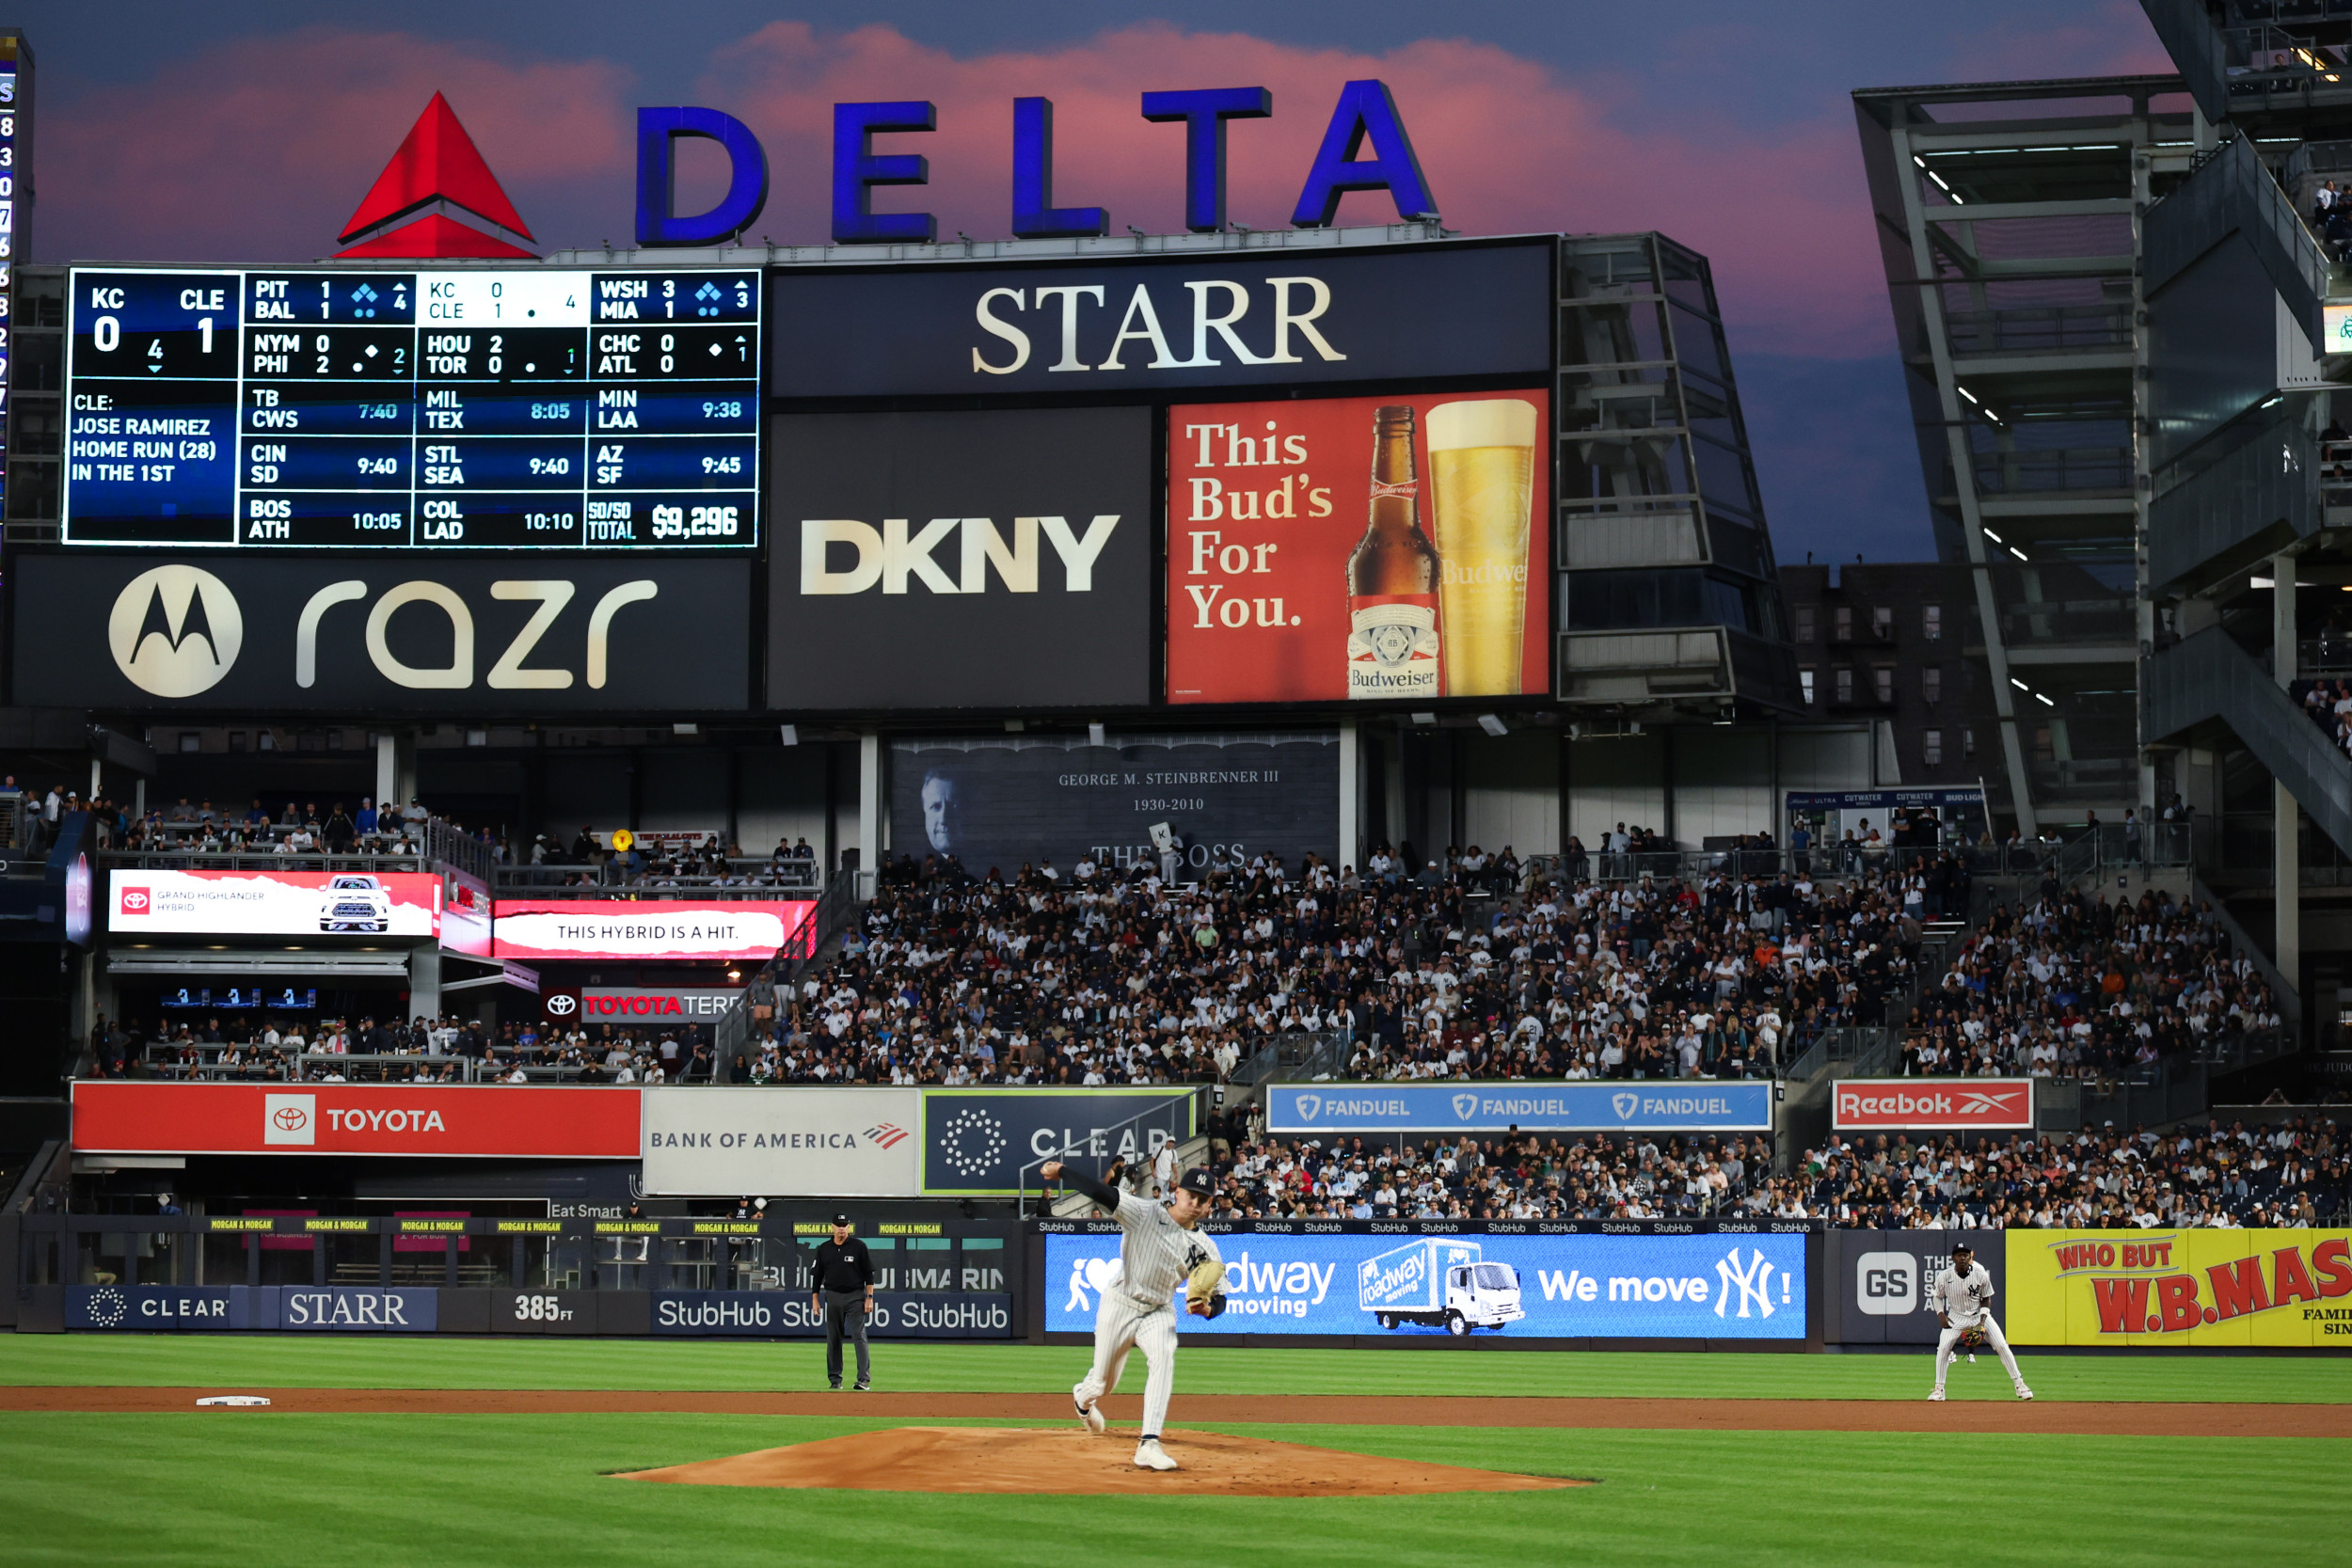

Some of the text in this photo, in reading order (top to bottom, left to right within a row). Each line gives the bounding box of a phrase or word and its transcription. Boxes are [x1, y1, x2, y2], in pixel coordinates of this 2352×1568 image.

[635, 79, 1440, 248] DELTA
[256, 281, 329, 298] PIT 1
[430, 282, 501, 297] KC 0
[600, 280, 675, 298] WSH 3
[92, 289, 224, 310] KC CLE
[393, 294, 406, 309] 4
[565, 294, 576, 308] 4
[737, 292, 748, 308] 3
[255, 301, 329, 319] BAL 1
[430, 303, 501, 318] CLE 1
[600, 302, 674, 319] MIA 1
[94, 316, 212, 353] 0 1
[972, 277, 1347, 376] STARR
[148, 340, 163, 359] 4
[254, 335, 328, 352] NYM 0
[427, 336, 502, 353] HOU 2
[599, 335, 674, 352] CHC 0
[254, 356, 329, 373] PHI 2
[394, 348, 405, 364] 2
[426, 356, 501, 373] TOR 0
[598, 356, 674, 372] ATL 0
[74, 395, 113, 411] CLE:
[252, 389, 278, 406] TB
[426, 390, 462, 407] MIL
[599, 390, 637, 407] MIN
[359, 404, 398, 419] 7:40
[531, 404, 570, 419] 8:05
[703, 402, 741, 418] 9:38
[73, 419, 210, 436] JOSE RAMIREZ
[252, 411, 298, 428] CWS
[426, 412, 464, 429] TEX
[598, 411, 638, 428] LAA
[72, 441, 216, 461] HOME RUN (28)
[1186, 420, 1308, 469] This
[251, 445, 286, 462] CIN
[425, 446, 462, 463] STL
[596, 446, 624, 463] AZ
[72, 465, 175, 482] IN THE 1ST
[358, 458, 397, 474] 9:40
[530, 458, 569, 474] 9:40
[702, 457, 740, 473] 9:45
[251, 466, 278, 483] SD
[424, 467, 464, 483] SEA
[596, 467, 623, 483] SF
[1187, 472, 1332, 522] Bud's
[250, 500, 291, 517] BOS
[423, 501, 463, 518] COL
[249, 521, 290, 539] ATH
[352, 514, 402, 530] 10:05
[525, 514, 573, 530] 10:10
[652, 504, 738, 539] $9,296
[423, 522, 463, 539] LAD
[588, 521, 636, 540] TOTAL
[800, 514, 1121, 595] DKNY
[1187, 531, 1277, 576] For
[1184, 582, 1302, 629] You.
[296, 579, 659, 689] razr
[1352, 670, 1434, 687] Budweiser
[1058, 770, 1279, 786] GEORGE M. STEINBRENNER III
[1133, 798, 1203, 811] 1930-2010
[157, 892, 264, 901] GRAND HIGHLANDER
[157, 903, 195, 911] HYBRID
[558, 926, 739, 939] THIS HYBRID IS A HIT.
[584, 996, 681, 1015] TOYOTA
[1325, 1100, 1731, 1116] FANDUEL FANDUEL FANDUEL
[1840, 1093, 1951, 1117] Reebok
[326, 1108, 446, 1132] TOYOTA
[651, 1132, 858, 1149] BANK OF AMERICA
[551, 1205, 622, 1217] Eat Smart
[212, 1220, 272, 1229] MORGAN & MORGAN
[694, 1224, 758, 1232] MORGAN & MORGAN
[880, 1225, 940, 1234] MORGAN & MORGAN
[1039, 1222, 1074, 1232] StubHub
[1255, 1223, 1342, 1232] StubHub StubHub
[1371, 1223, 1526, 1232] StubHub StubHub StubHub
[1601, 1223, 1757, 1233] StubHub StubHub
[2055, 1242, 2171, 1271] WHO BUT
[1363, 1248, 1425, 1305] roadway
[1866, 1270, 1908, 1297] GS
[1385, 1279, 1418, 1303] moving
[1537, 1270, 1597, 1302] We
[1609, 1276, 1708, 1302] move
[141, 1299, 226, 1317] CLEAR
[290, 1292, 408, 1325] STARR
[515, 1295, 559, 1321] 385
[659, 1300, 1008, 1328] StubHub StubHub
[1225, 1295, 1307, 1318] moving
